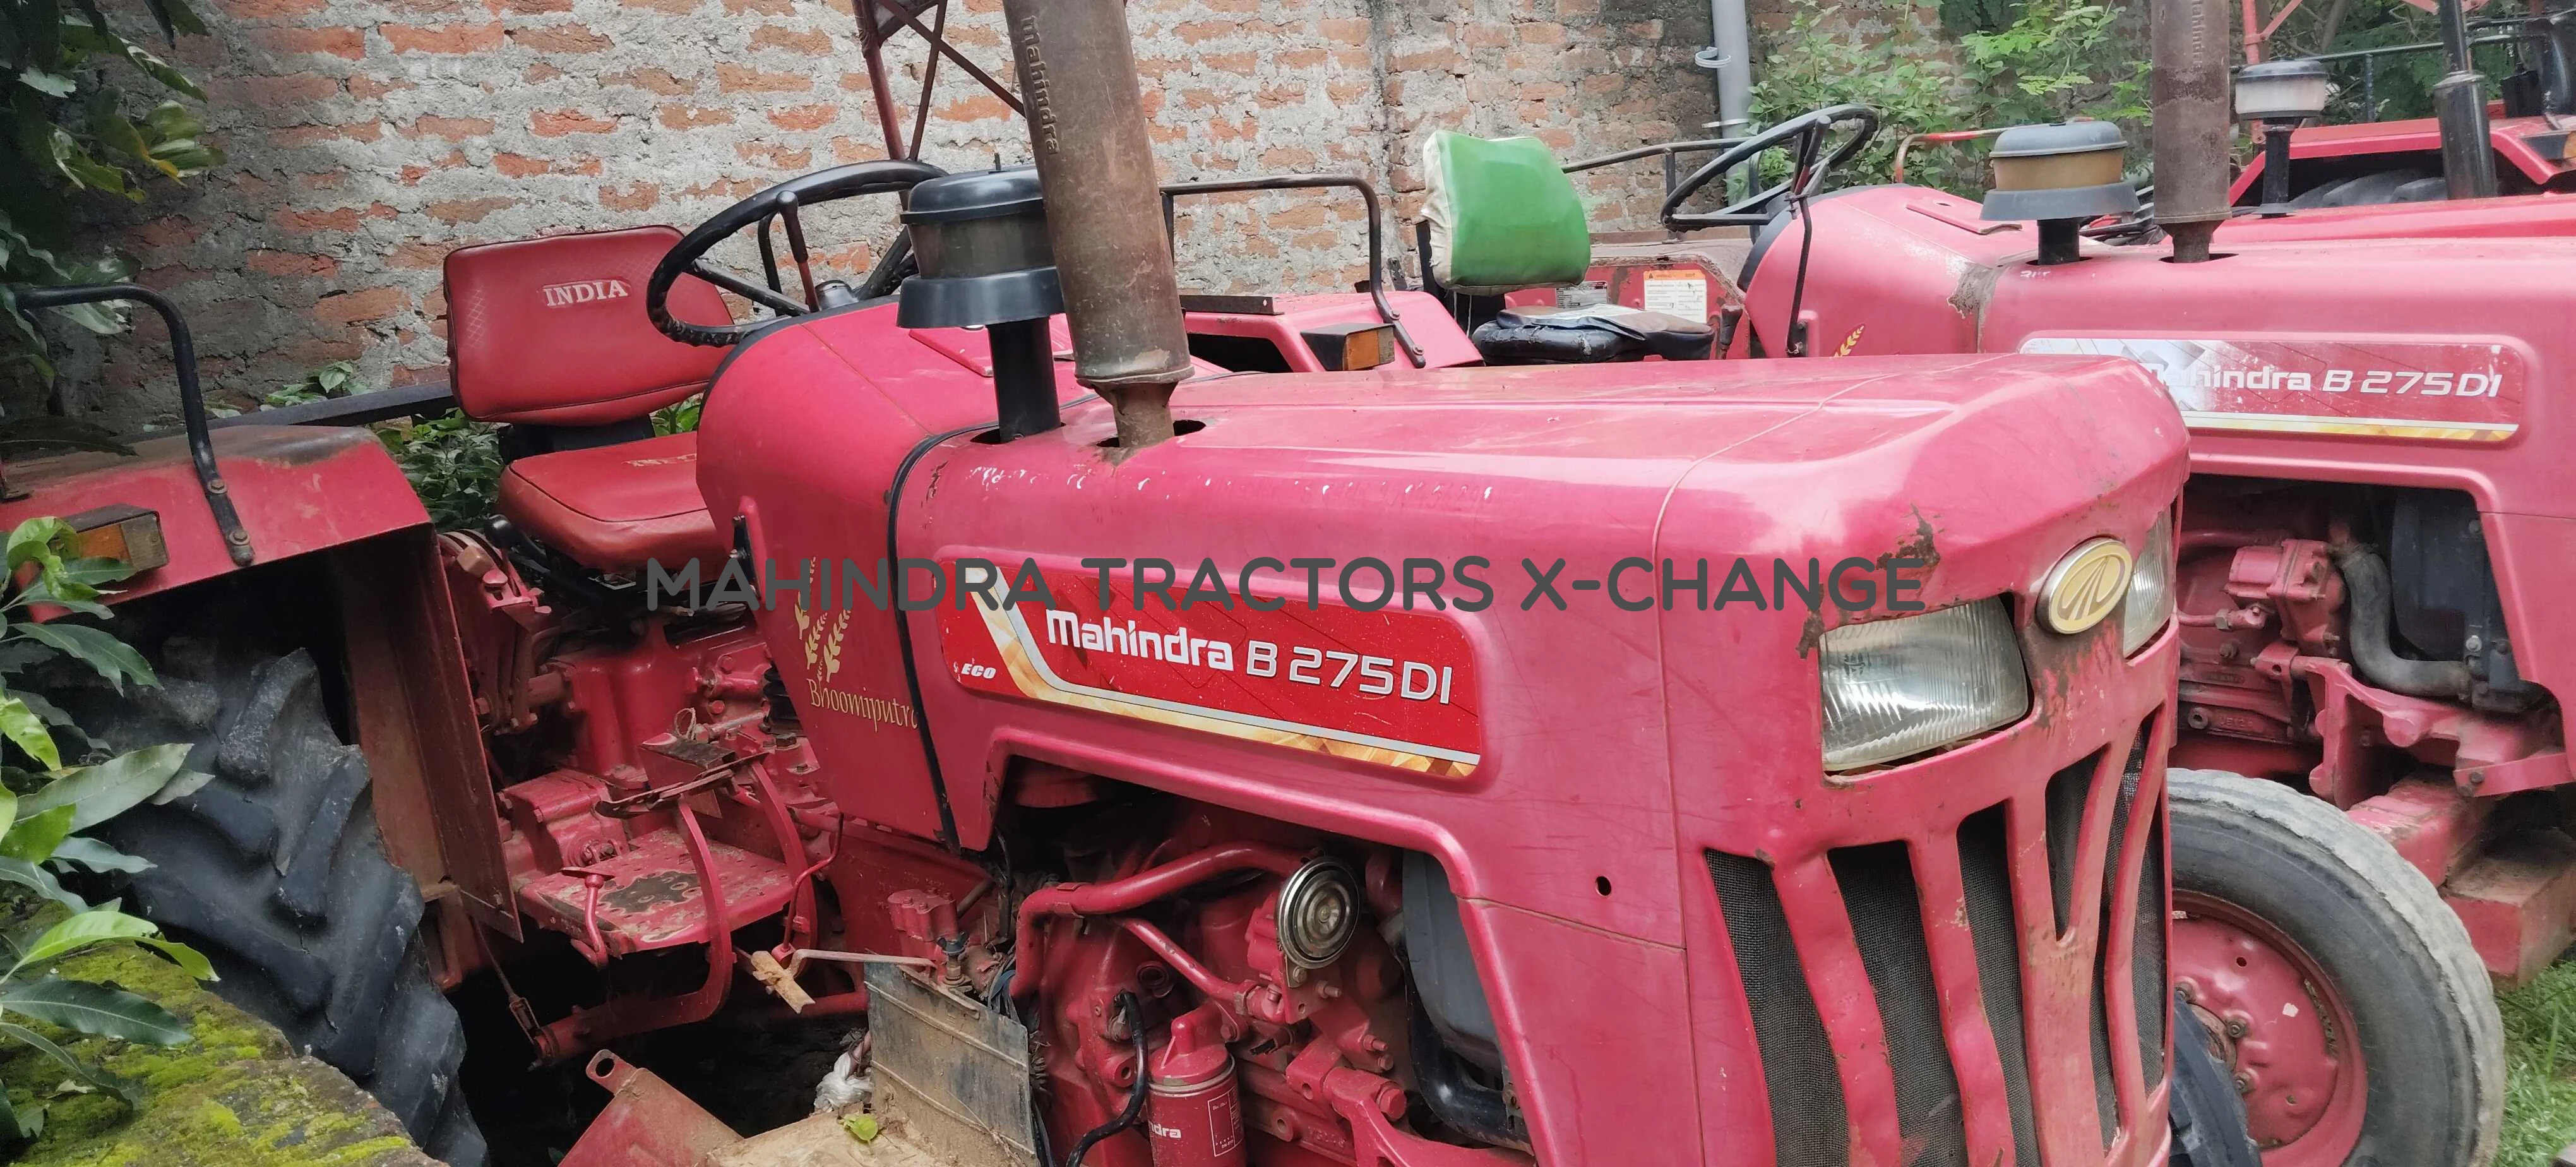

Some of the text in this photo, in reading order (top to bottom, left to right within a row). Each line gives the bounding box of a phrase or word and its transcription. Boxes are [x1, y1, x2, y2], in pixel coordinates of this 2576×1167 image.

[543, 280, 628, 306] INDIA
[2322, 369, 2354, 392] B
[960, 662, 997, 679] ECO
[1246, 640, 1278, 678] B
